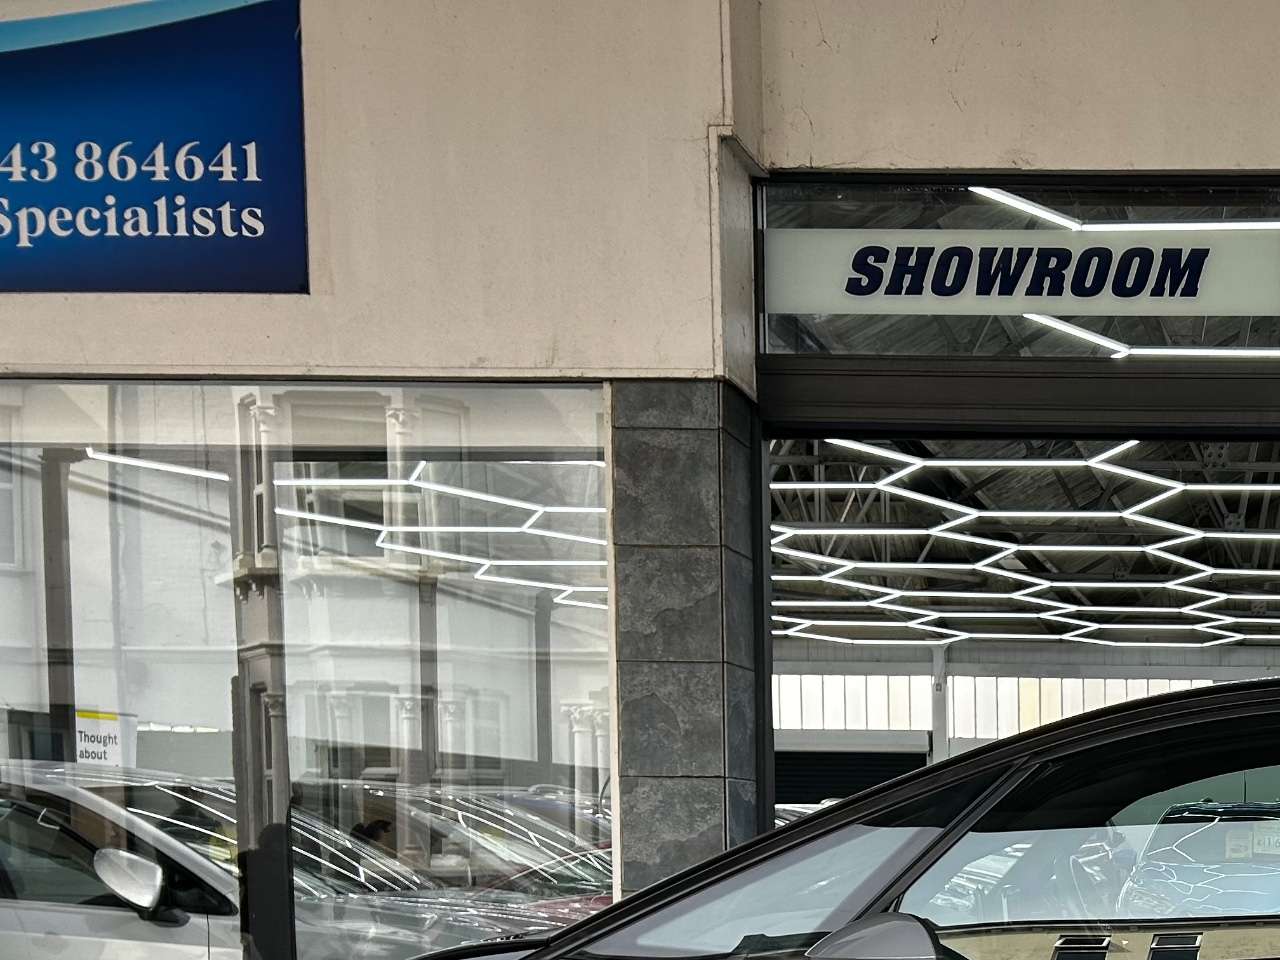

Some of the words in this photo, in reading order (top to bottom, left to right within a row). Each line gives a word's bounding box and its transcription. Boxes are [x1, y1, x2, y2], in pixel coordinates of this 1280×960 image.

[74, 141, 262, 182] 864641
[845, 245, 1210, 298] SHOWROOM
[78, 730, 118, 747] Thought
[79, 748, 108, 760] about
